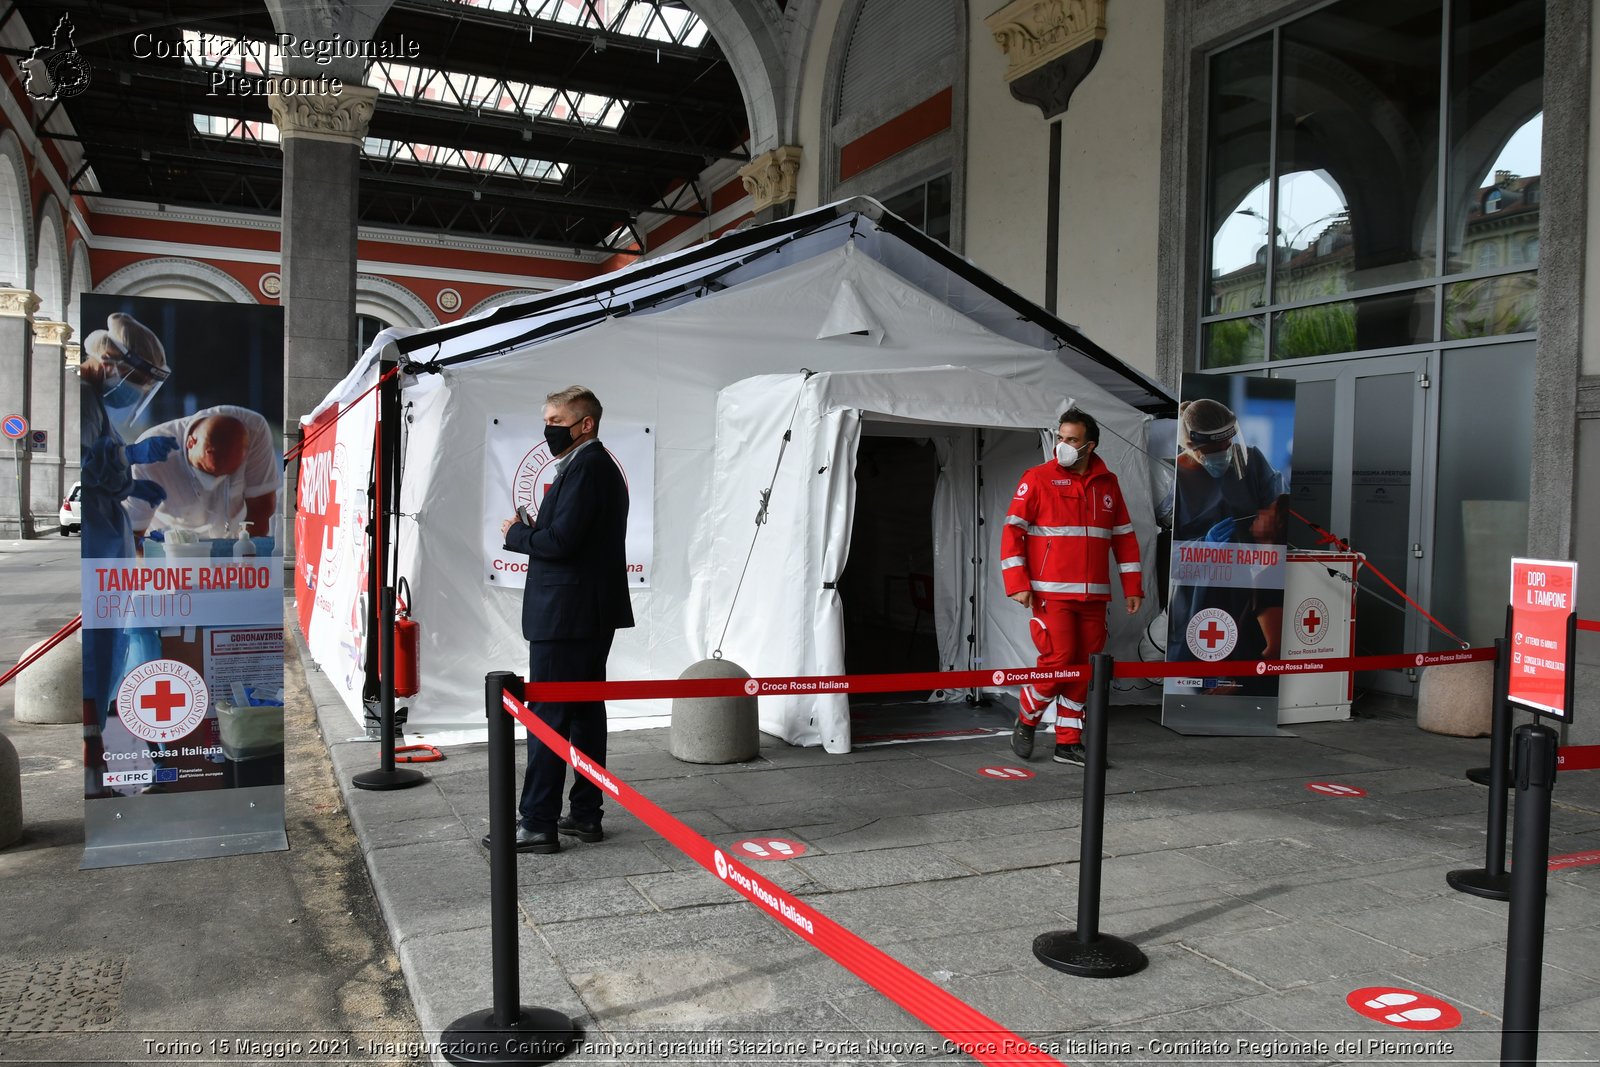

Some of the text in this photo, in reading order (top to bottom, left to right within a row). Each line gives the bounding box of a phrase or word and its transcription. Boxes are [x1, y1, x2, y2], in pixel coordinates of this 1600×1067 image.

[533, 449, 550, 466] DI
[1179, 547, 1278, 566] TAMPONE RAPIDO
[493, 559, 529, 573] Croc
[1178, 564, 1232, 581] GRATUITO
[96, 566, 270, 592] TAMPONE RAPIDO
[1527, 571, 1546, 587] DOPO
[96, 593, 192, 619] GRATUITO
[1527, 589, 1567, 609] IL TAMPONE
[231, 632, 283, 642] CORONAVIRUS
[131, 670, 145, 682] DI
[144, 662, 190, 680] GINEVRA
[1006, 669, 1080, 681] Croce Rossa Italiana
[188, 676, 201, 688] 22
[761, 679, 849, 691] Croce Rossa Italiana
[120, 682, 157, 739] CONVENZIONE
[190, 688, 206, 726] AGOSTO
[169, 722, 190, 738] 1864
[102, 745, 223, 761] Croce Rossa Italiana
[123, 772, 149, 782] IFRC
[577, 755, 619, 796] Croce Rossa Italiana
[728, 864, 814, 935] Croce Rossa Italiana
